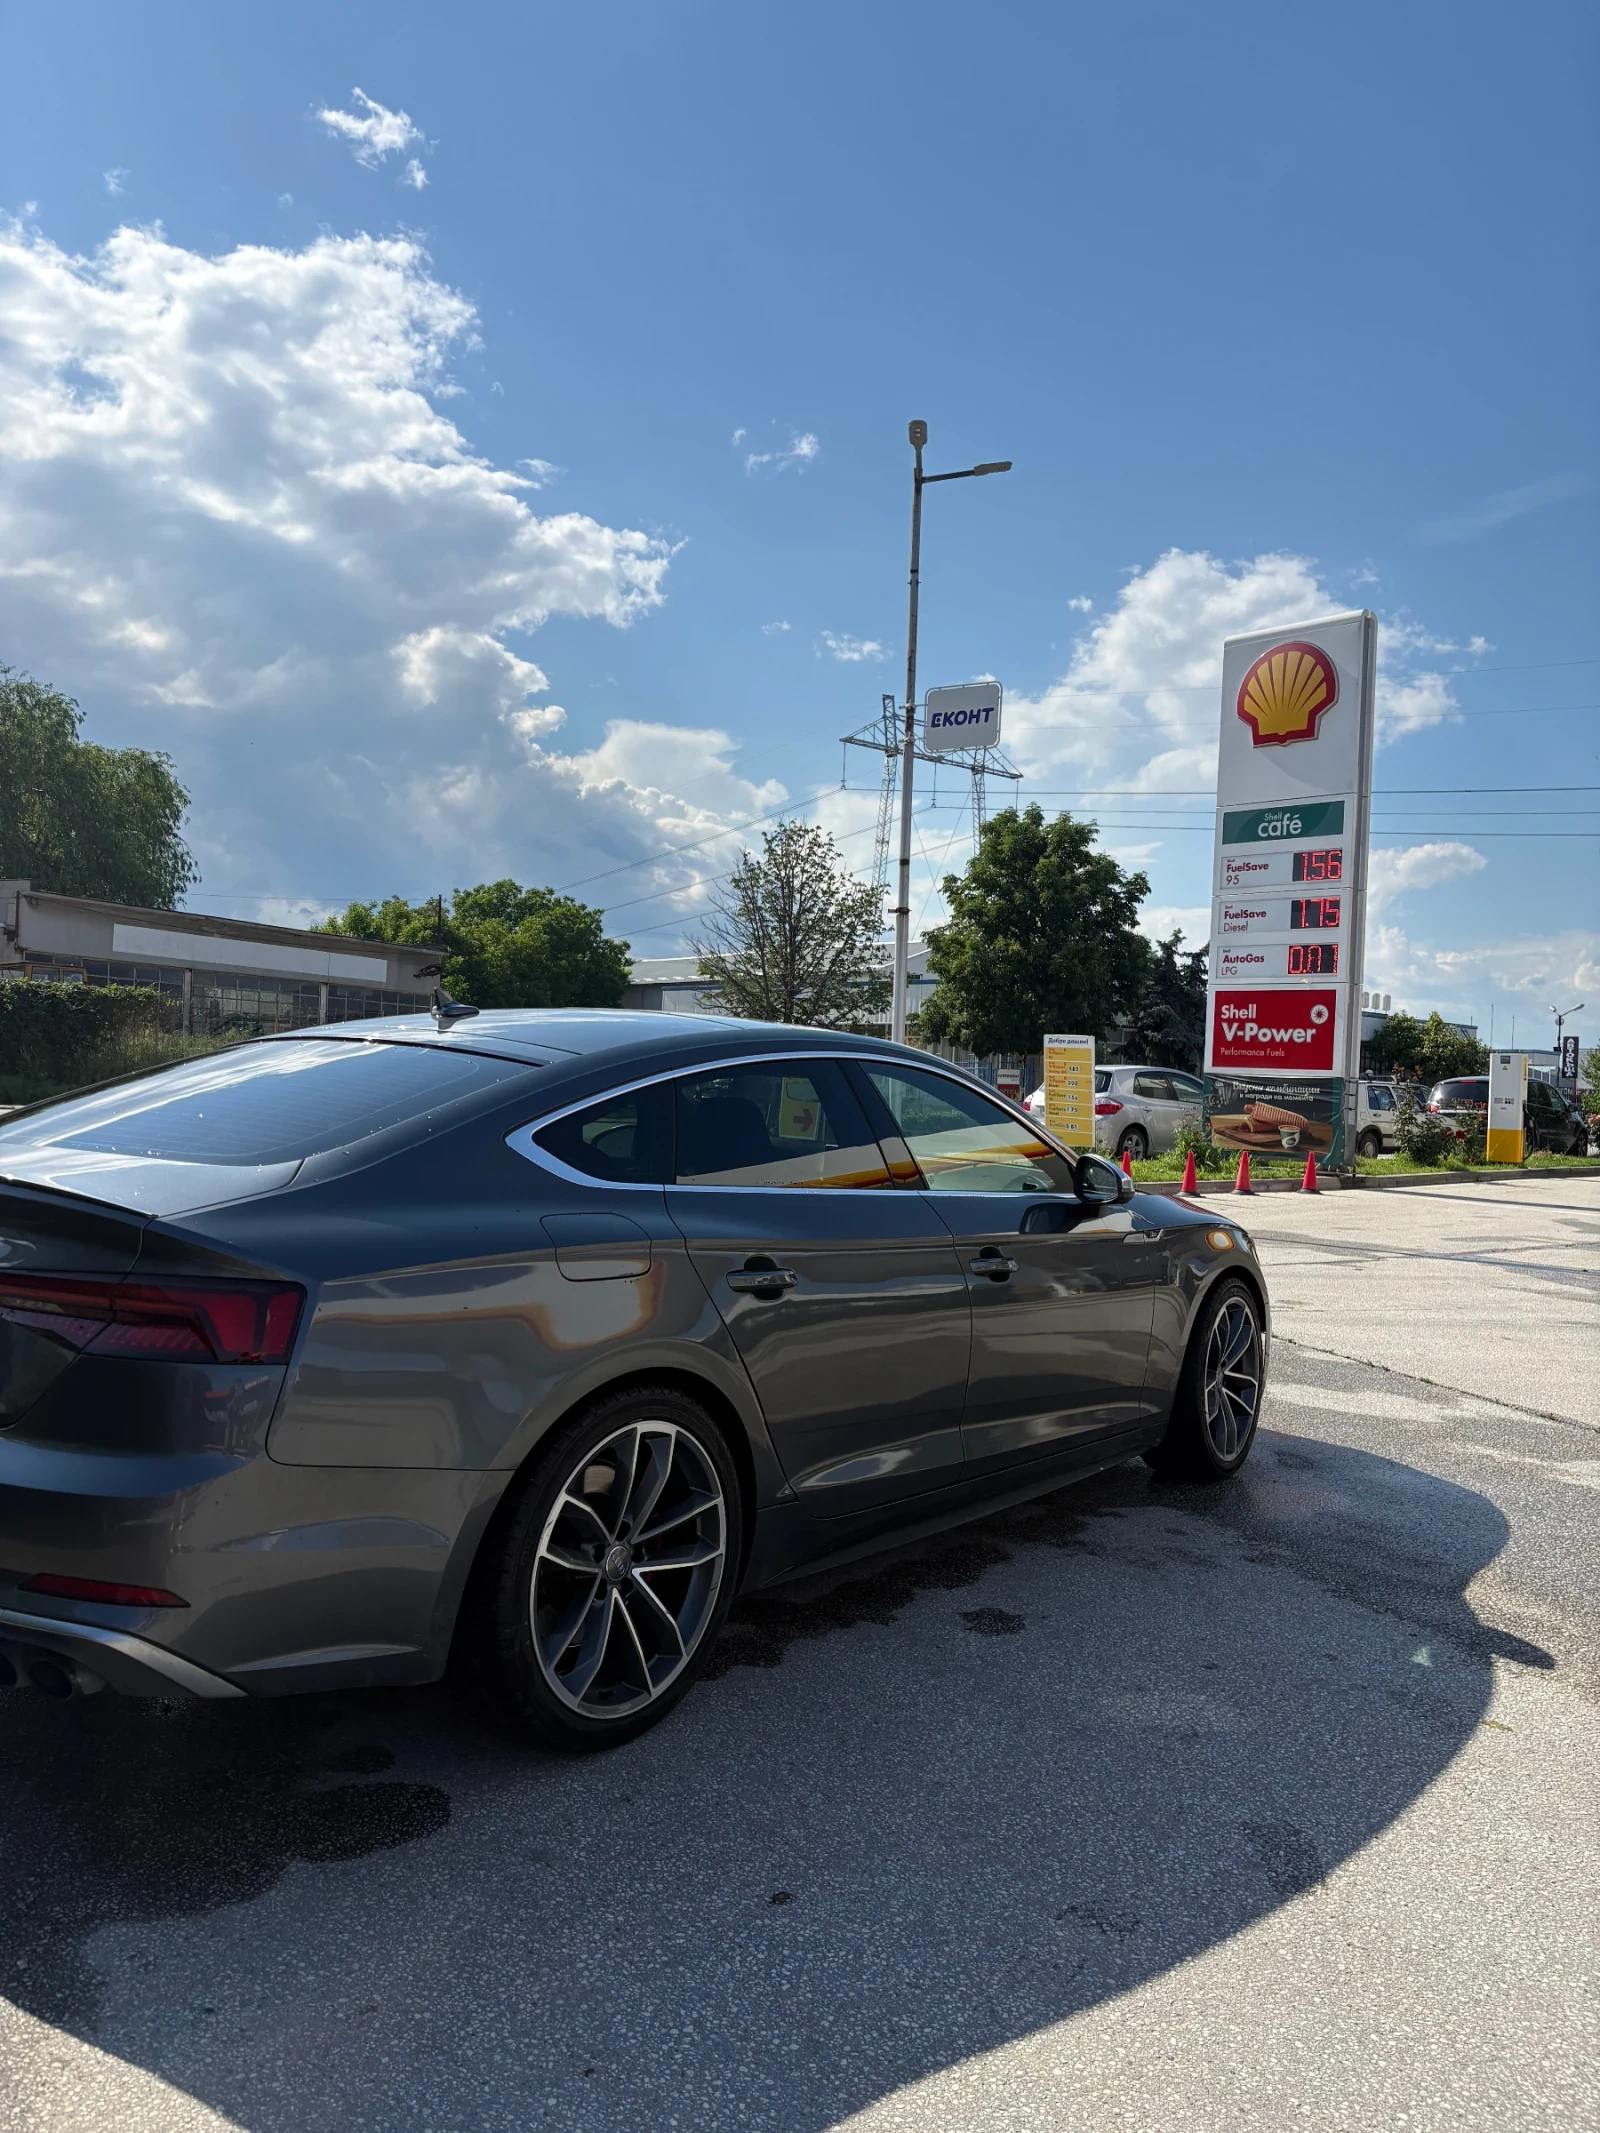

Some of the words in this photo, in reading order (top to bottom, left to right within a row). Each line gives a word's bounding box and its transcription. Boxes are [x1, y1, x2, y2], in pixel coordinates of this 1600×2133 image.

[931, 707, 995, 728] ЕКОНТ
[1264, 811, 1282, 821] Shell
[1257, 813, 1302, 837] café
[1226, 862, 1269, 873] FuelSave
[1302, 850, 1342, 881] 1.56
[1226, 875, 1240, 885] 95
[1224, 909, 1267, 920] FuelSave
[1300, 897, 1340, 928] 1.75
[1223, 921, 1249, 932] Diesel
[1222, 953, 1265, 964] AutoGas
[1221, 966, 1238, 975] LPG
[1221, 1003, 1257, 1019] Shell
[1221, 1022, 1316, 1043] V-Power
[1220, 1047, 1265, 1056] Performance
[1266, 1048, 1285, 1057] Fuels
